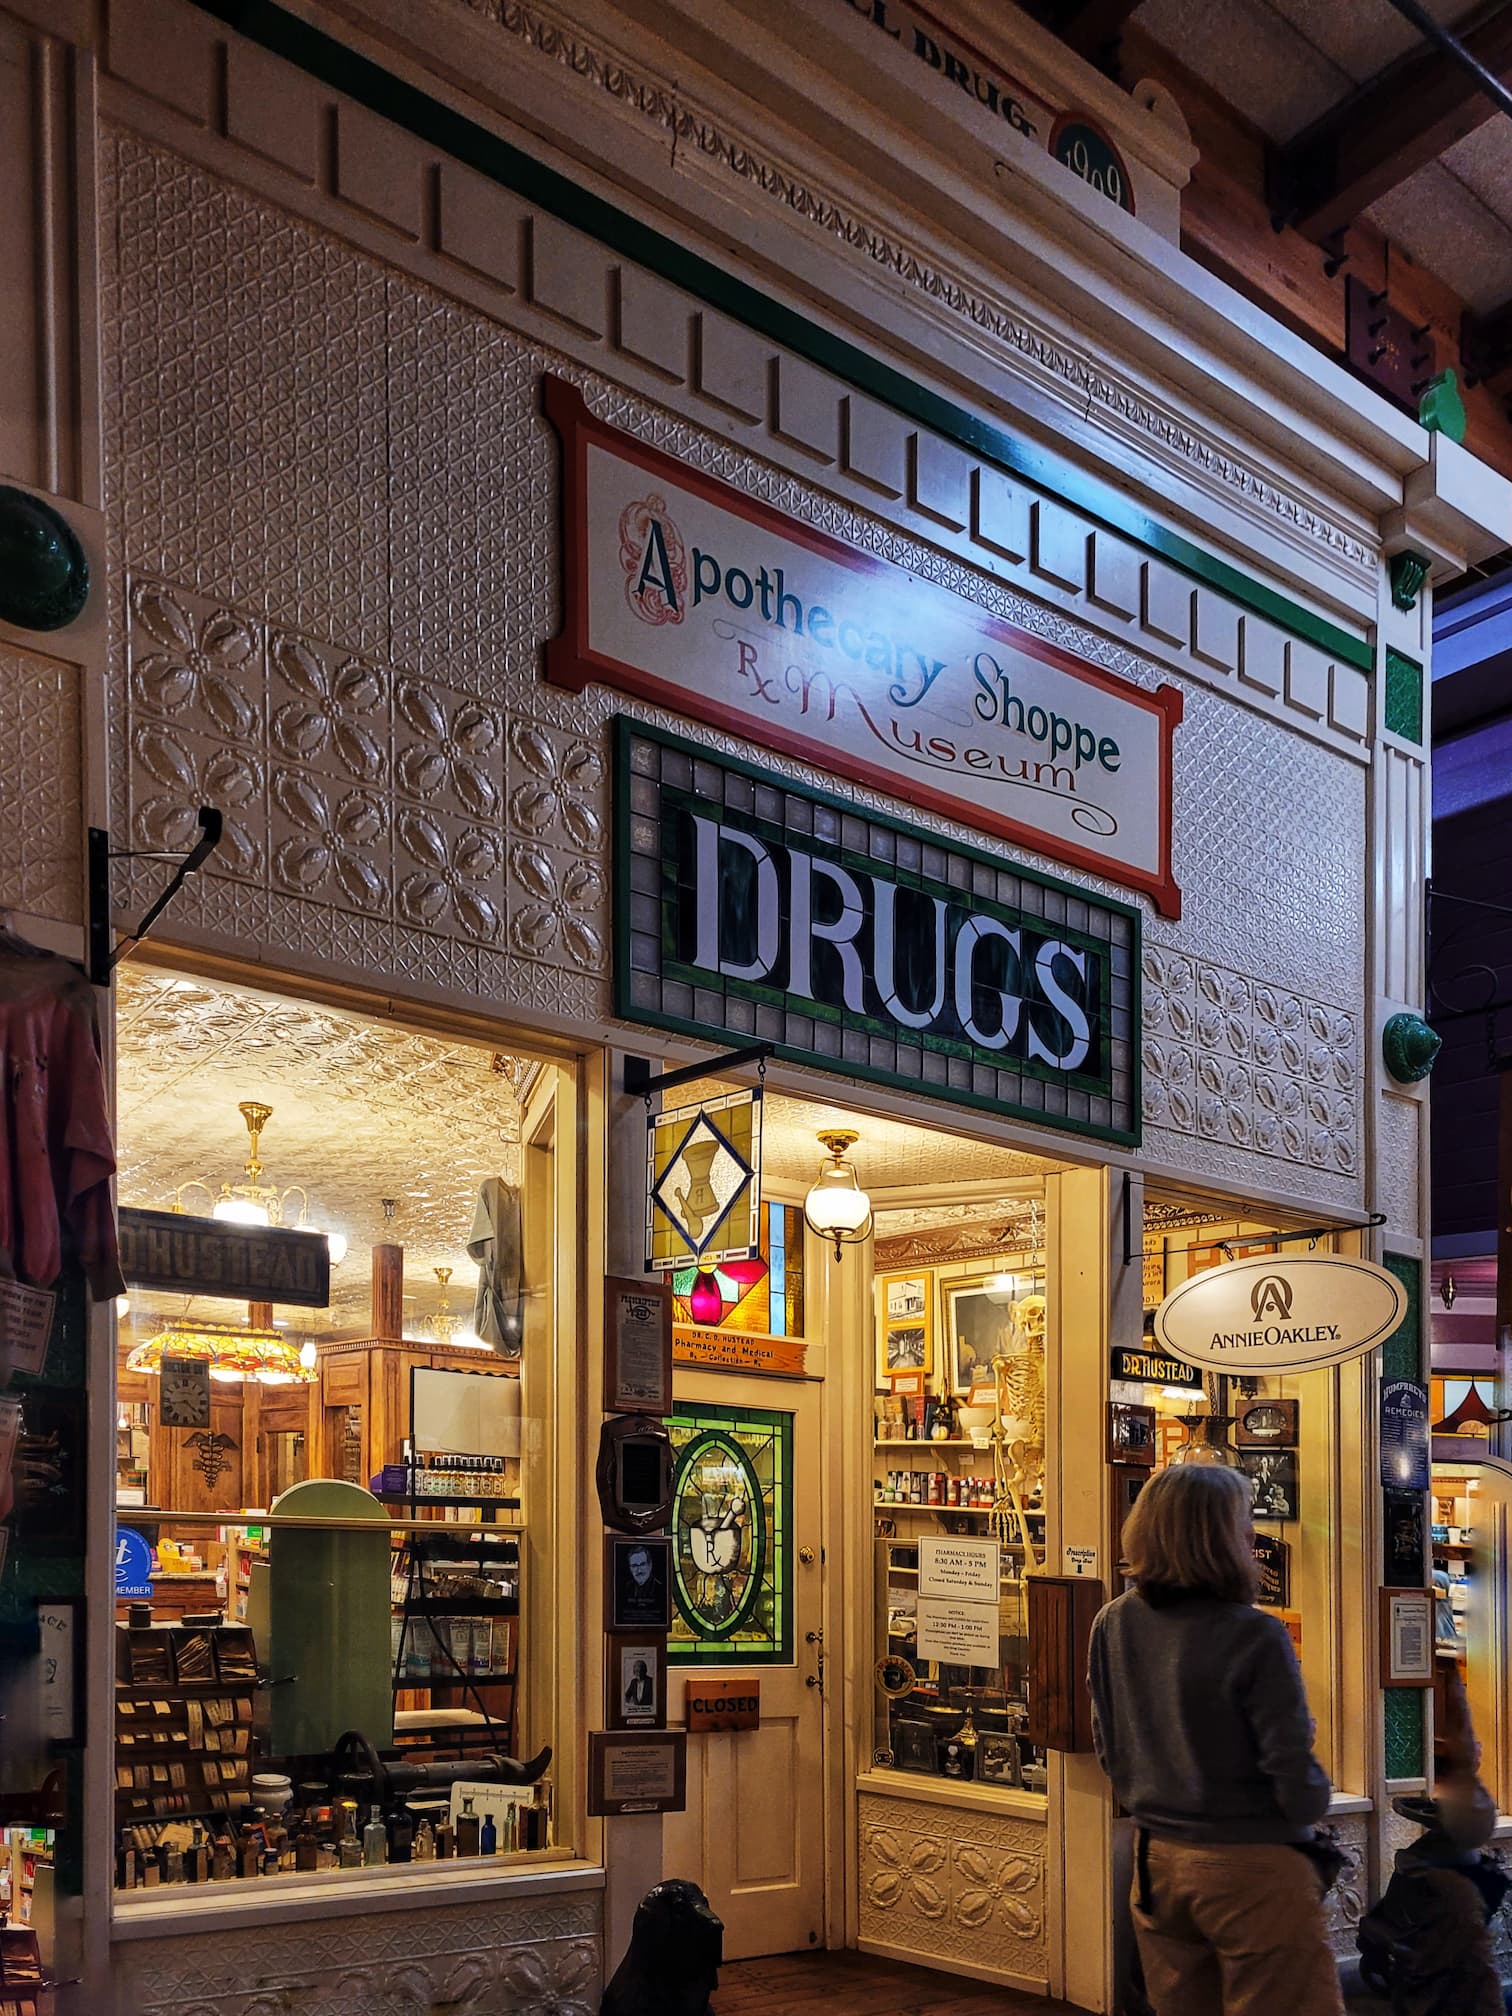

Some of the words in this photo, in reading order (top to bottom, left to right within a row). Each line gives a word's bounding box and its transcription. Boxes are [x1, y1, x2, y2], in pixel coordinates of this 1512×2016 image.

[914, 27, 1037, 138] DRUG
[632, 518, 947, 707] Apothecary
[975, 653, 1121, 772] Shoppe
[785, 665, 1078, 792] Museum
[693, 815, 1090, 1071] DRUGS
[675, 1338, 717, 1352] Pharmacy
[722, 1345, 736, 1354] and
[742, 1346, 774, 1358] Medical
[1385, 1406, 1425, 1418] REMEDIES
[692, 1696, 758, 1713] CLOSED
